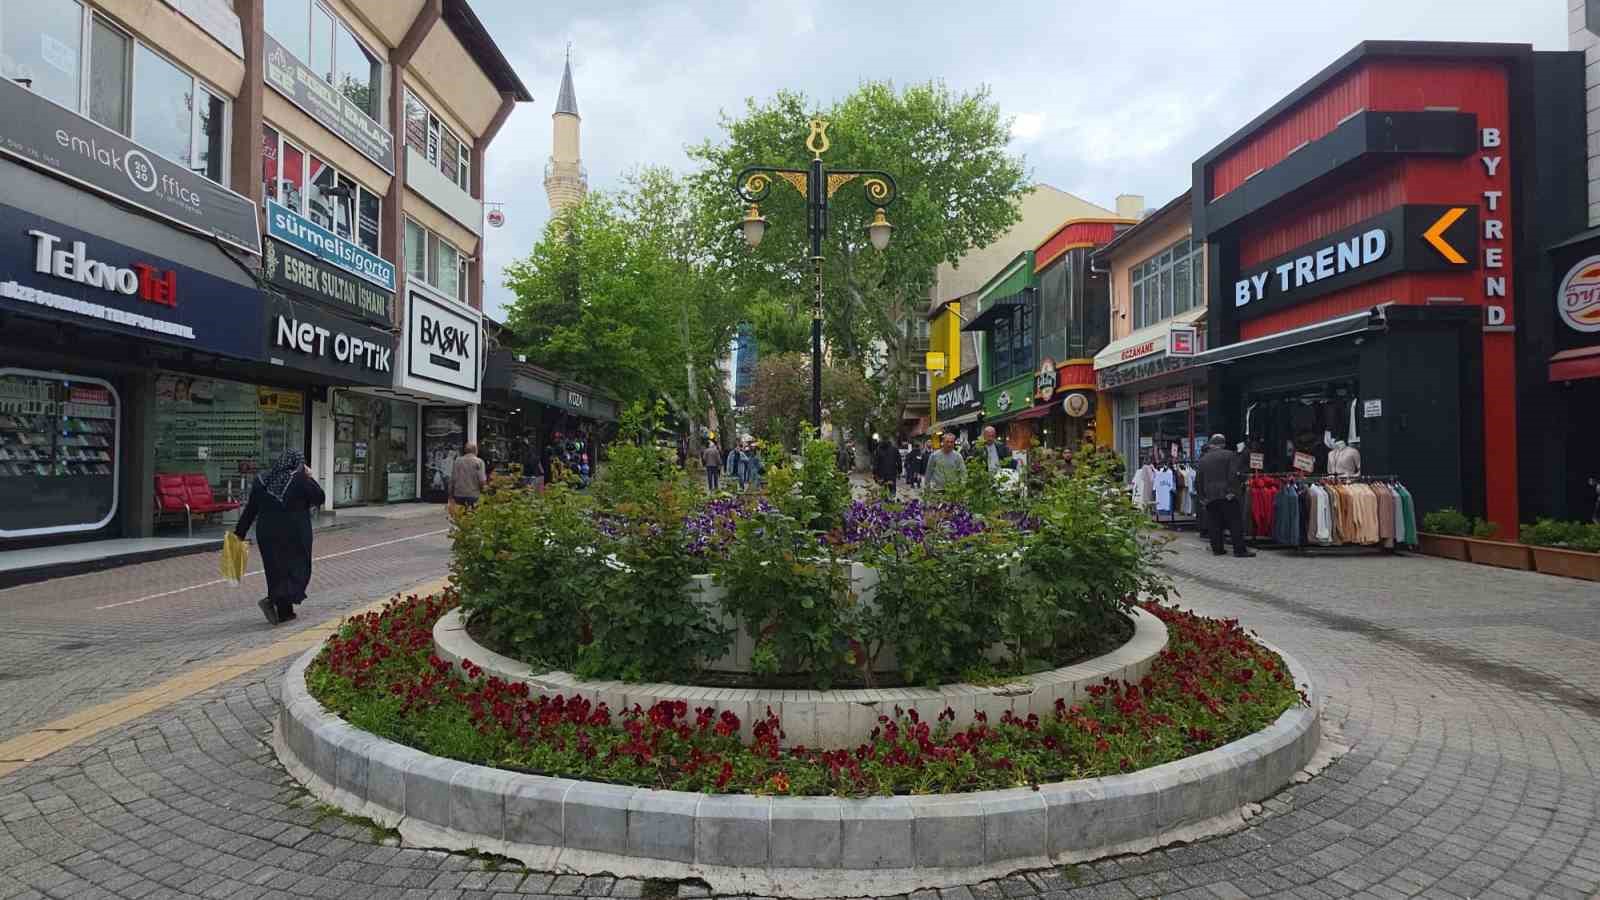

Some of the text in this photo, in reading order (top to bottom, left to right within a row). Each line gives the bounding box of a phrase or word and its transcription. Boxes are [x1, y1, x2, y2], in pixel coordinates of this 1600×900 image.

[56, 129, 122, 172] emlak
[343, 104, 391, 152] EMLAK
[1235, 227, 1387, 307] BY TREND
[1483, 190, 1506, 326] TREND
[321, 272, 356, 305] SULTAN
